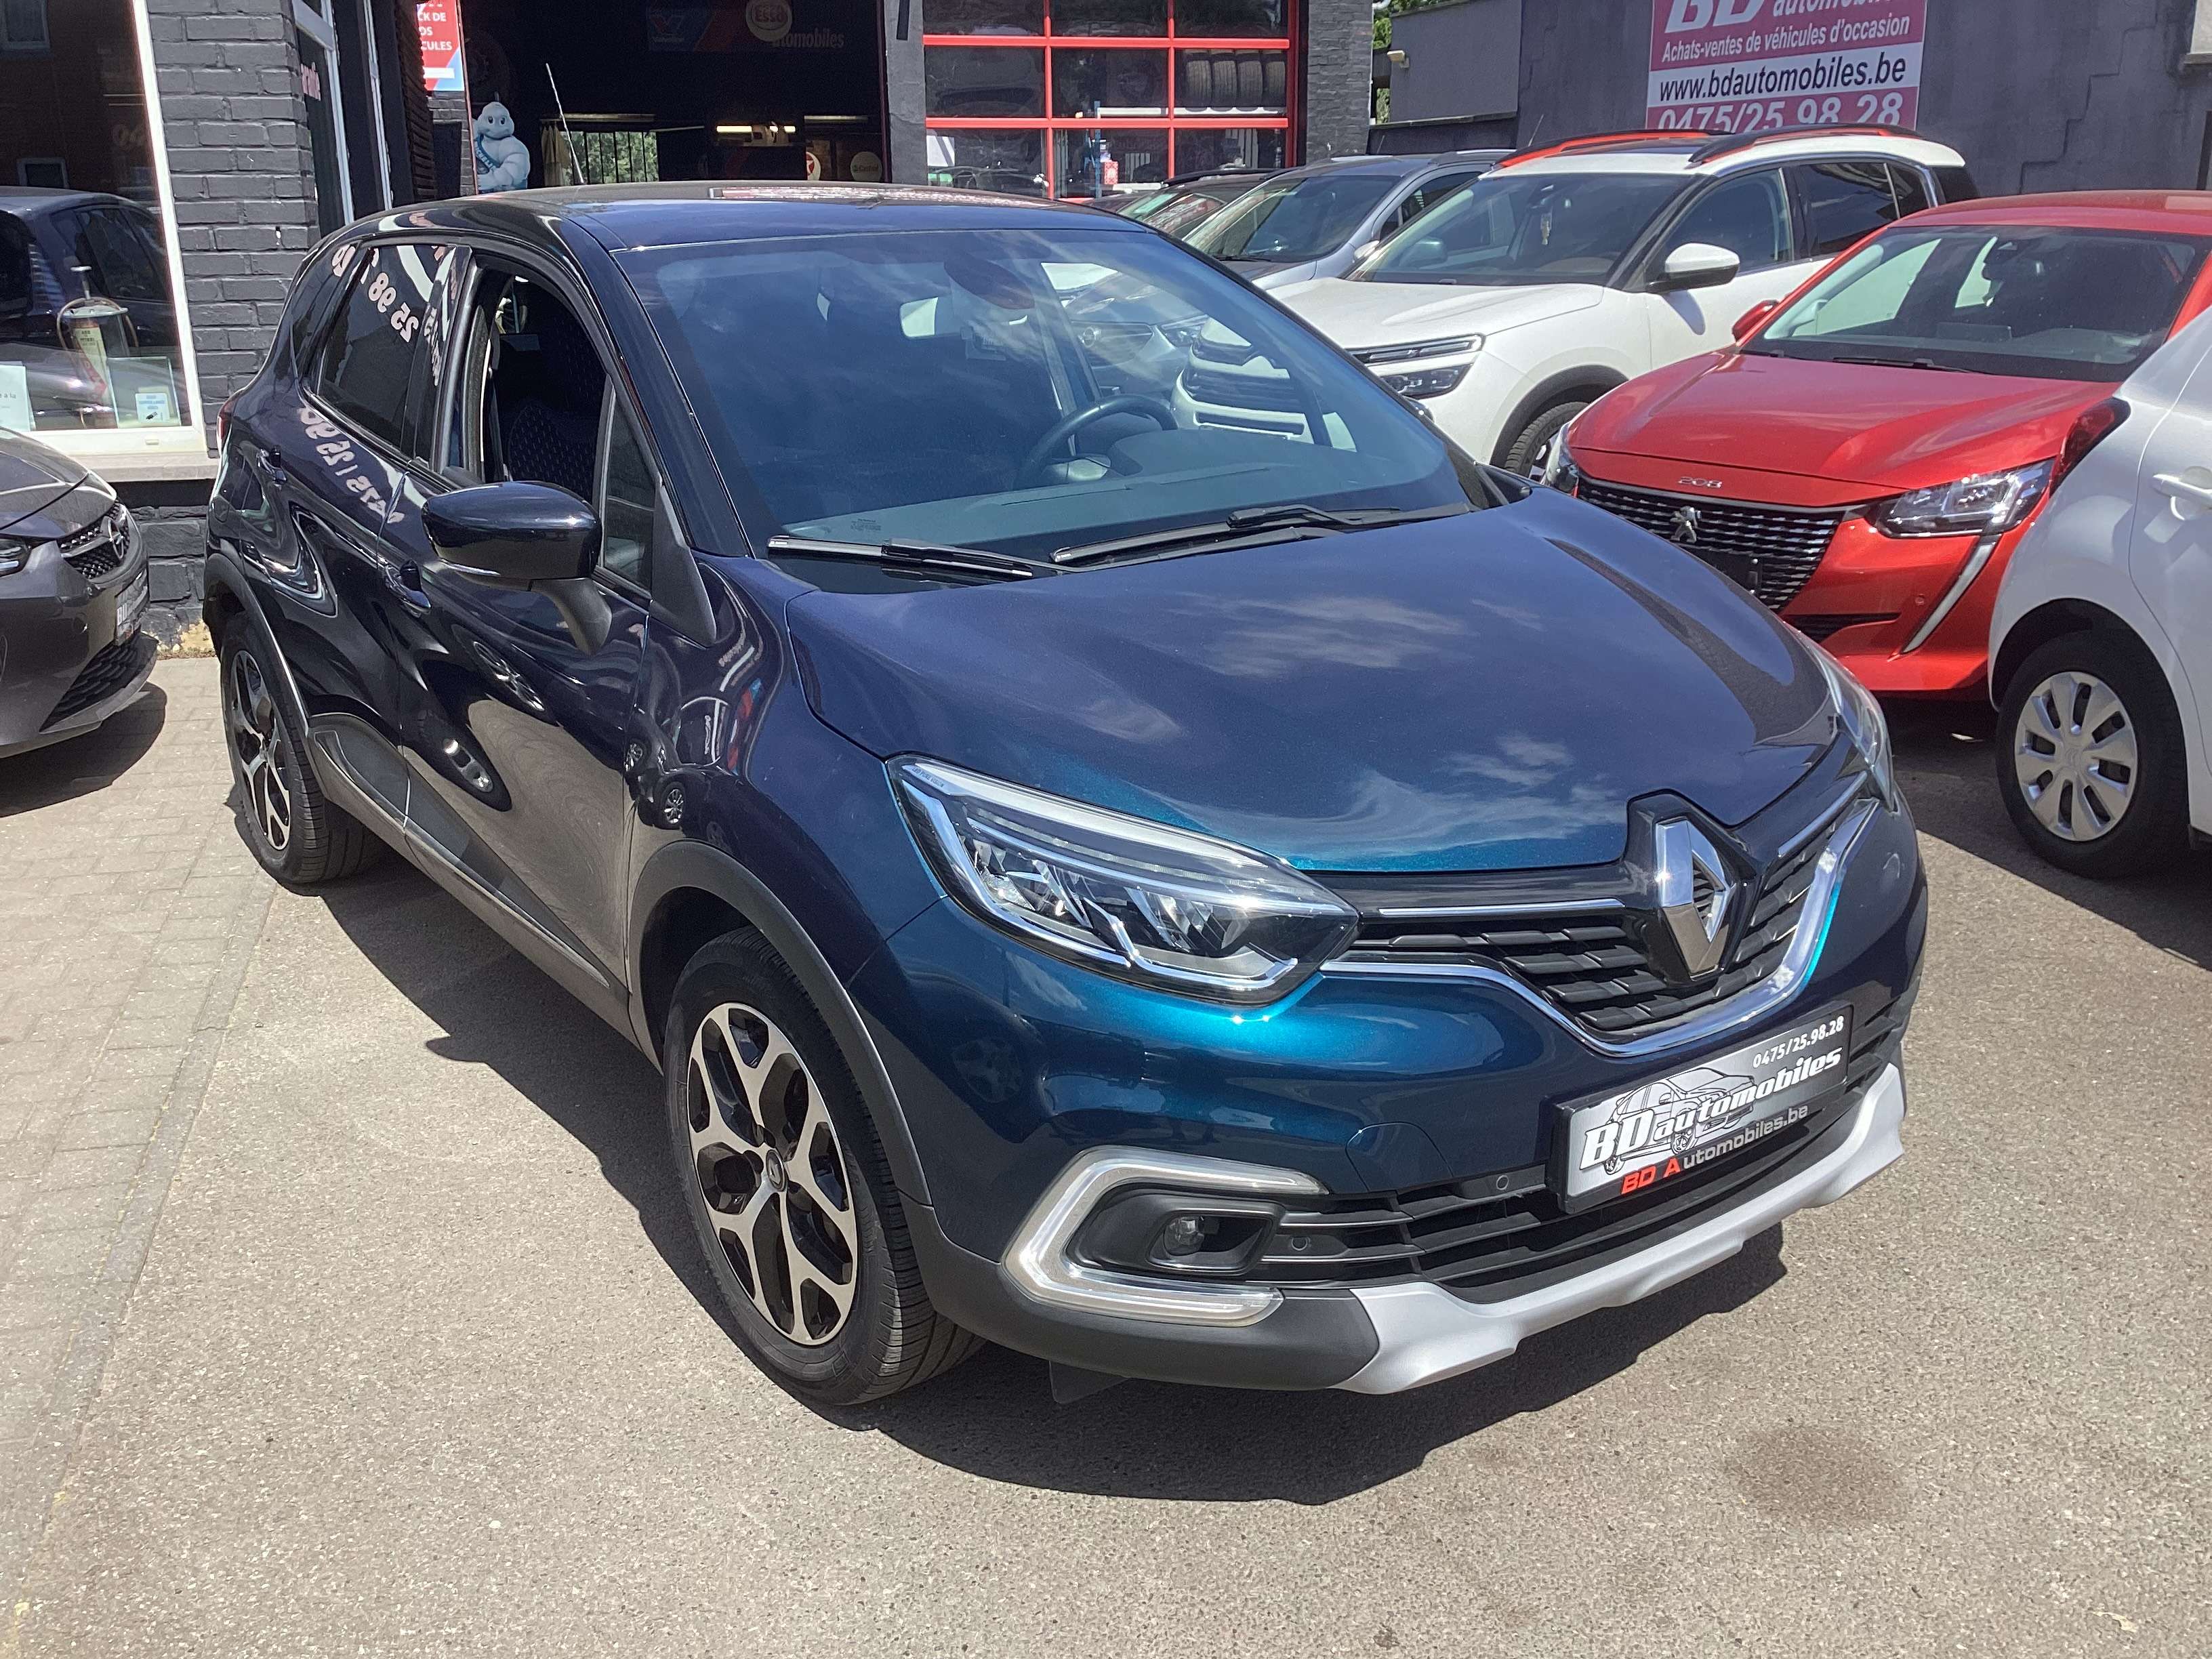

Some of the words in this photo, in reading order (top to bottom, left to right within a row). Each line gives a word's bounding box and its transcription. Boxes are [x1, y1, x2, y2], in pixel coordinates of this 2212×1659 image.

[417, 12, 431, 21] CK
[432, 12, 447, 22] DE
[418, 26, 434, 36] OS
[421, 41, 453, 51] CULES
[1662, 35, 1743, 62] Achats-ventes
[1746, 30, 1762, 52] de
[1765, 22, 1827, 52] véhicules
[1830, 13, 1910, 43] d'occasion
[1660, 52, 1906, 102] www.bdautomobiles.be
[1857, 91, 1903, 126] 28
[1677, 476, 1723, 489] 208
[1753, 1015, 1845, 1069] 0475/25.98.28
[1621, 1164, 1657, 1195] BD
